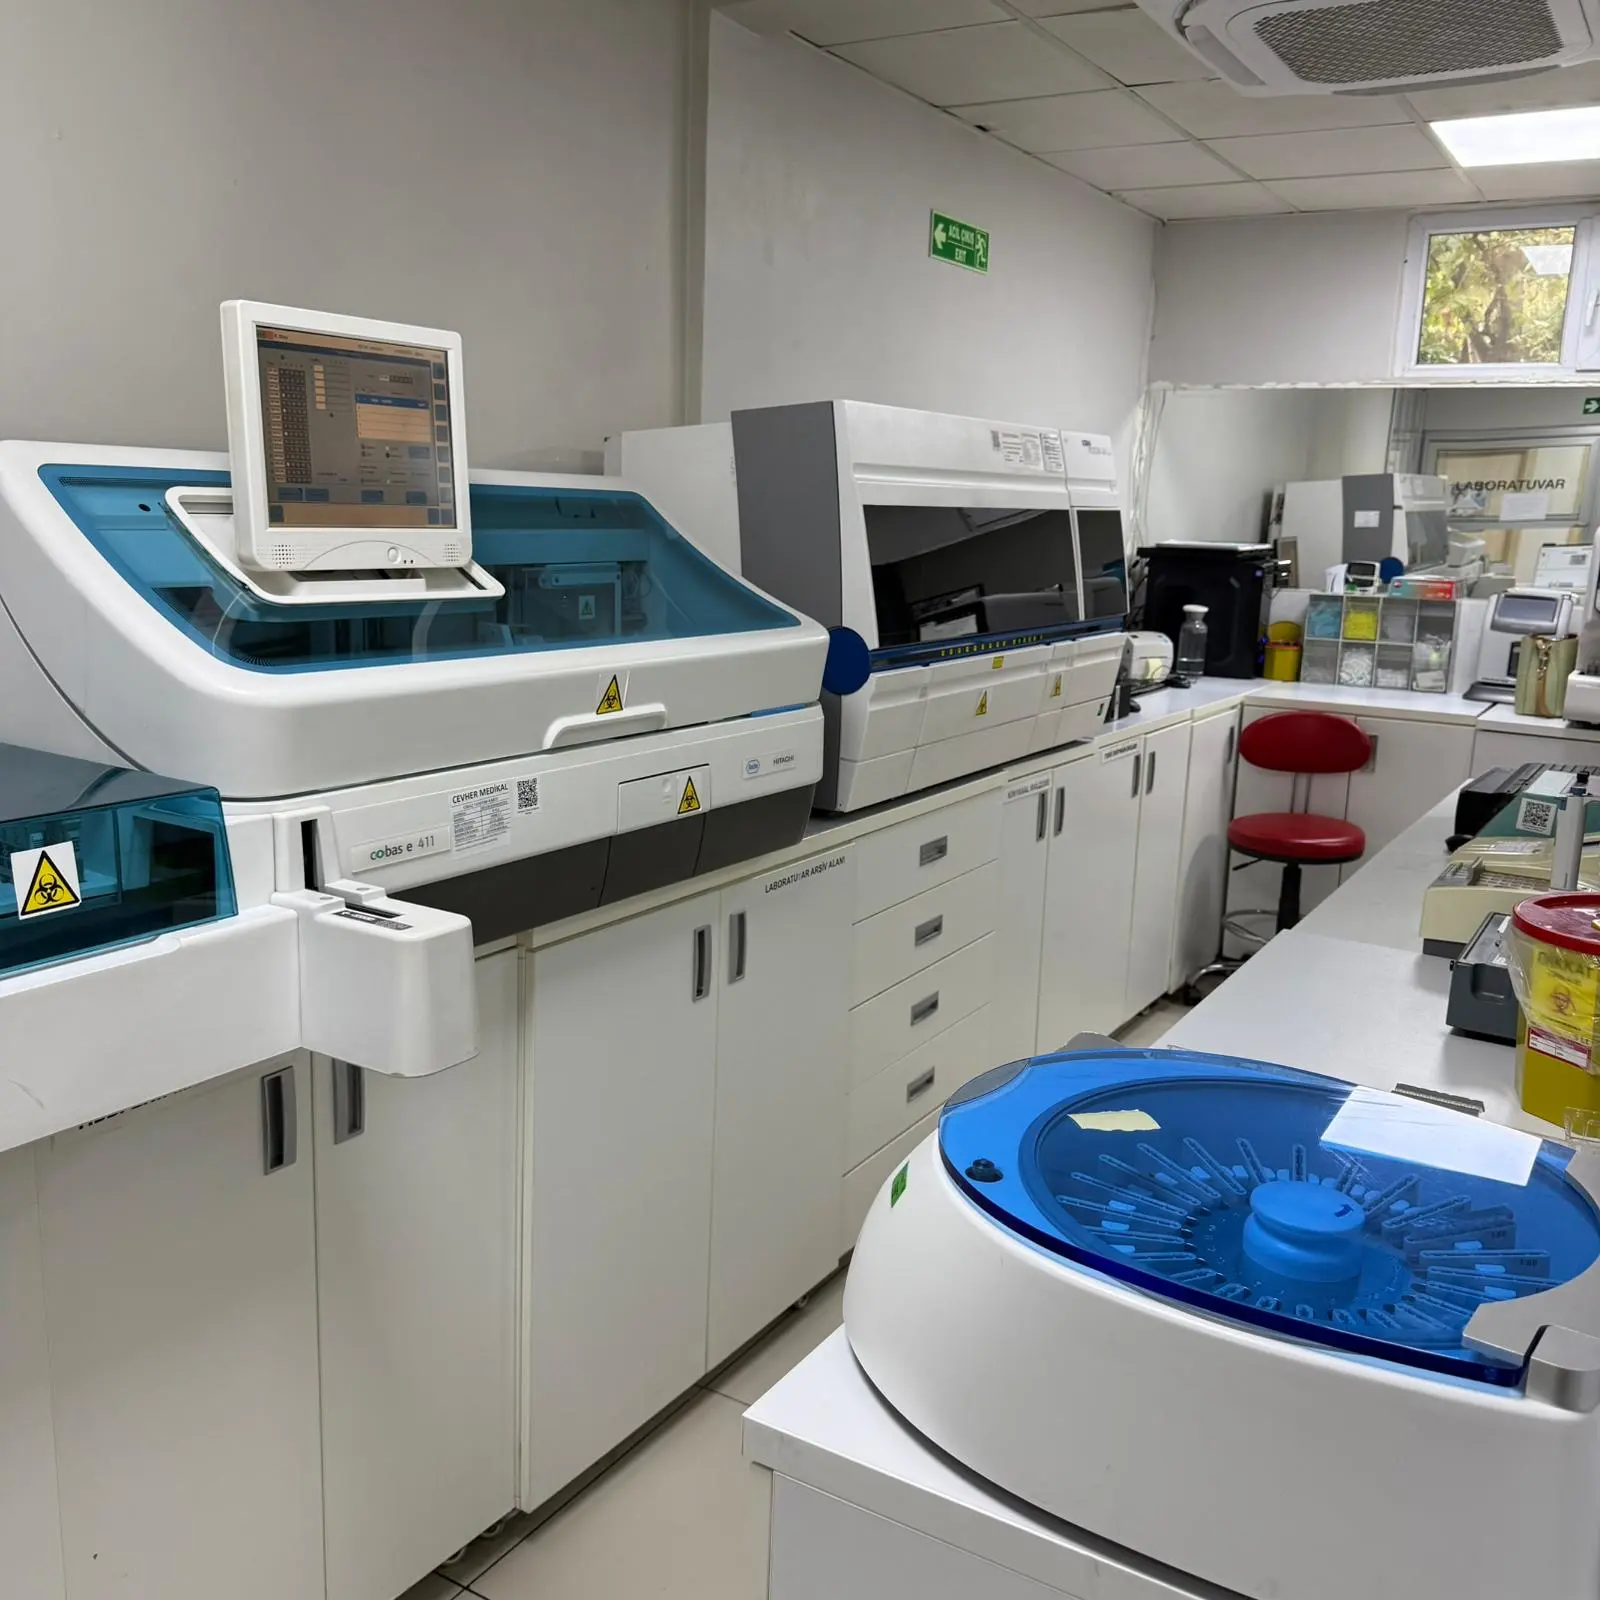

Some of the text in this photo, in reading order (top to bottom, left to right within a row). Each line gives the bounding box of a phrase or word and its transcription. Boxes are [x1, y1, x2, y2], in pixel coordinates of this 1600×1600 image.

[1455, 478, 1565, 491] LABORATUVAR
[773, 755, 794, 765] HITACHI
[452, 783, 508, 804] CEVHER MEDİKAL
[370, 835, 434, 860] cobas e 411
[765, 869, 810, 894] LABORATUAR
